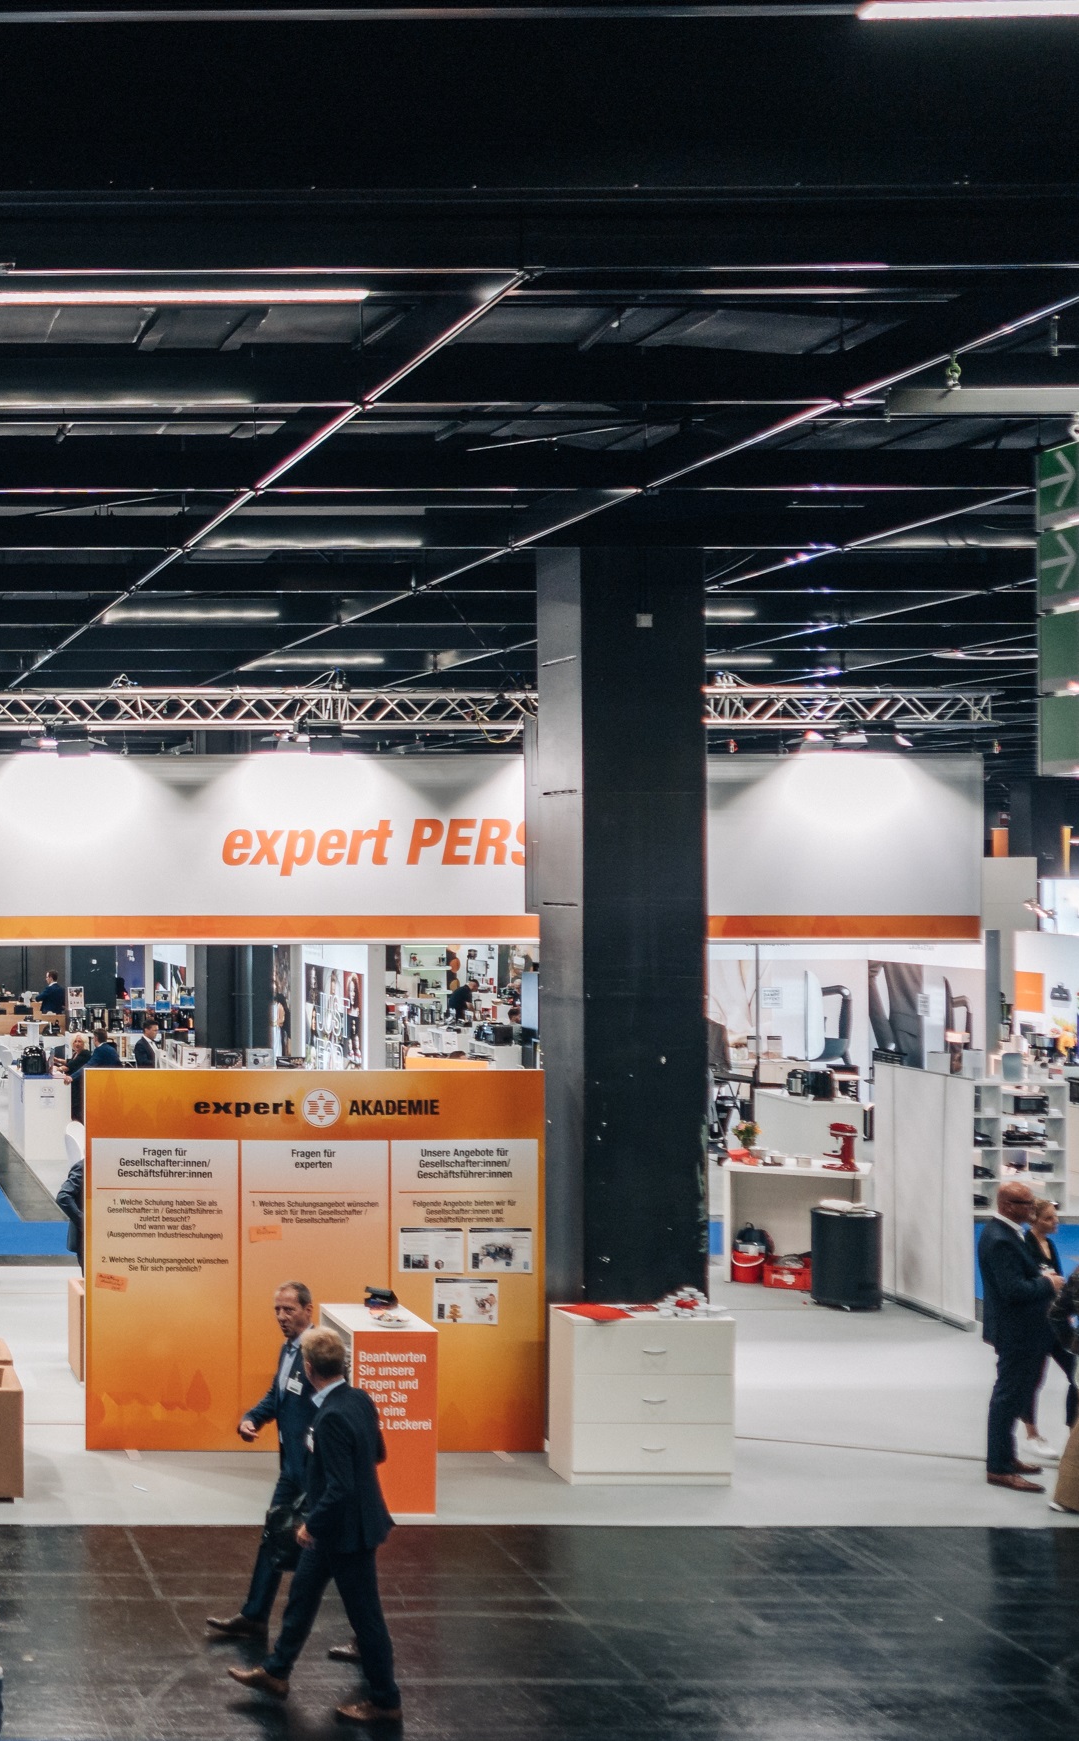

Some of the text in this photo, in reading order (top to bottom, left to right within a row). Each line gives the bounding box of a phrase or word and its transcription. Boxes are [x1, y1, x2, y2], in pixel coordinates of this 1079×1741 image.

[222, 819, 393, 876] expert
[193, 1099, 440, 1118] expert AKADEMIE
[143, 1147, 187, 1158] Fragen für
[291, 1149, 336, 1159] Fragen für
[421, 1148, 509, 1159] Unsere Angebote für
[119, 1158, 211, 1168] Gesellschafter:innen/
[294, 1161, 333, 1171] experten
[419, 1158, 511, 1168] Gesellschafter:innen/
[117, 1169, 213, 1179] Geschäftsführer:innen
[417, 1170, 513, 1179] Geschäftsführer:innen
[144, 1199, 174, 1208] Schulung
[287, 1201, 345, 1209] Schulungsangebot
[413, 1200, 442, 1208] Folgende
[443, 1200, 473, 1208] Angebote
[507, 1199, 516, 1207] für
[107, 1231, 224, 1240] (Ausgenommen Industrieschulungen)
[109, 1256, 135, 1264] Welches
[137, 1257, 195, 1266] Schulungsangebot
[165, 1265, 202, 1273] persönlich?
[358, 1351, 427, 1363] Beantworten
[358, 1364, 415, 1376] Sie unsere
[359, 1379, 419, 1391] Fragen und
[390, 1392, 408, 1403] Sie
[383, 1406, 406, 1417] eine
[386, 1419, 432, 1430] Leckerei
